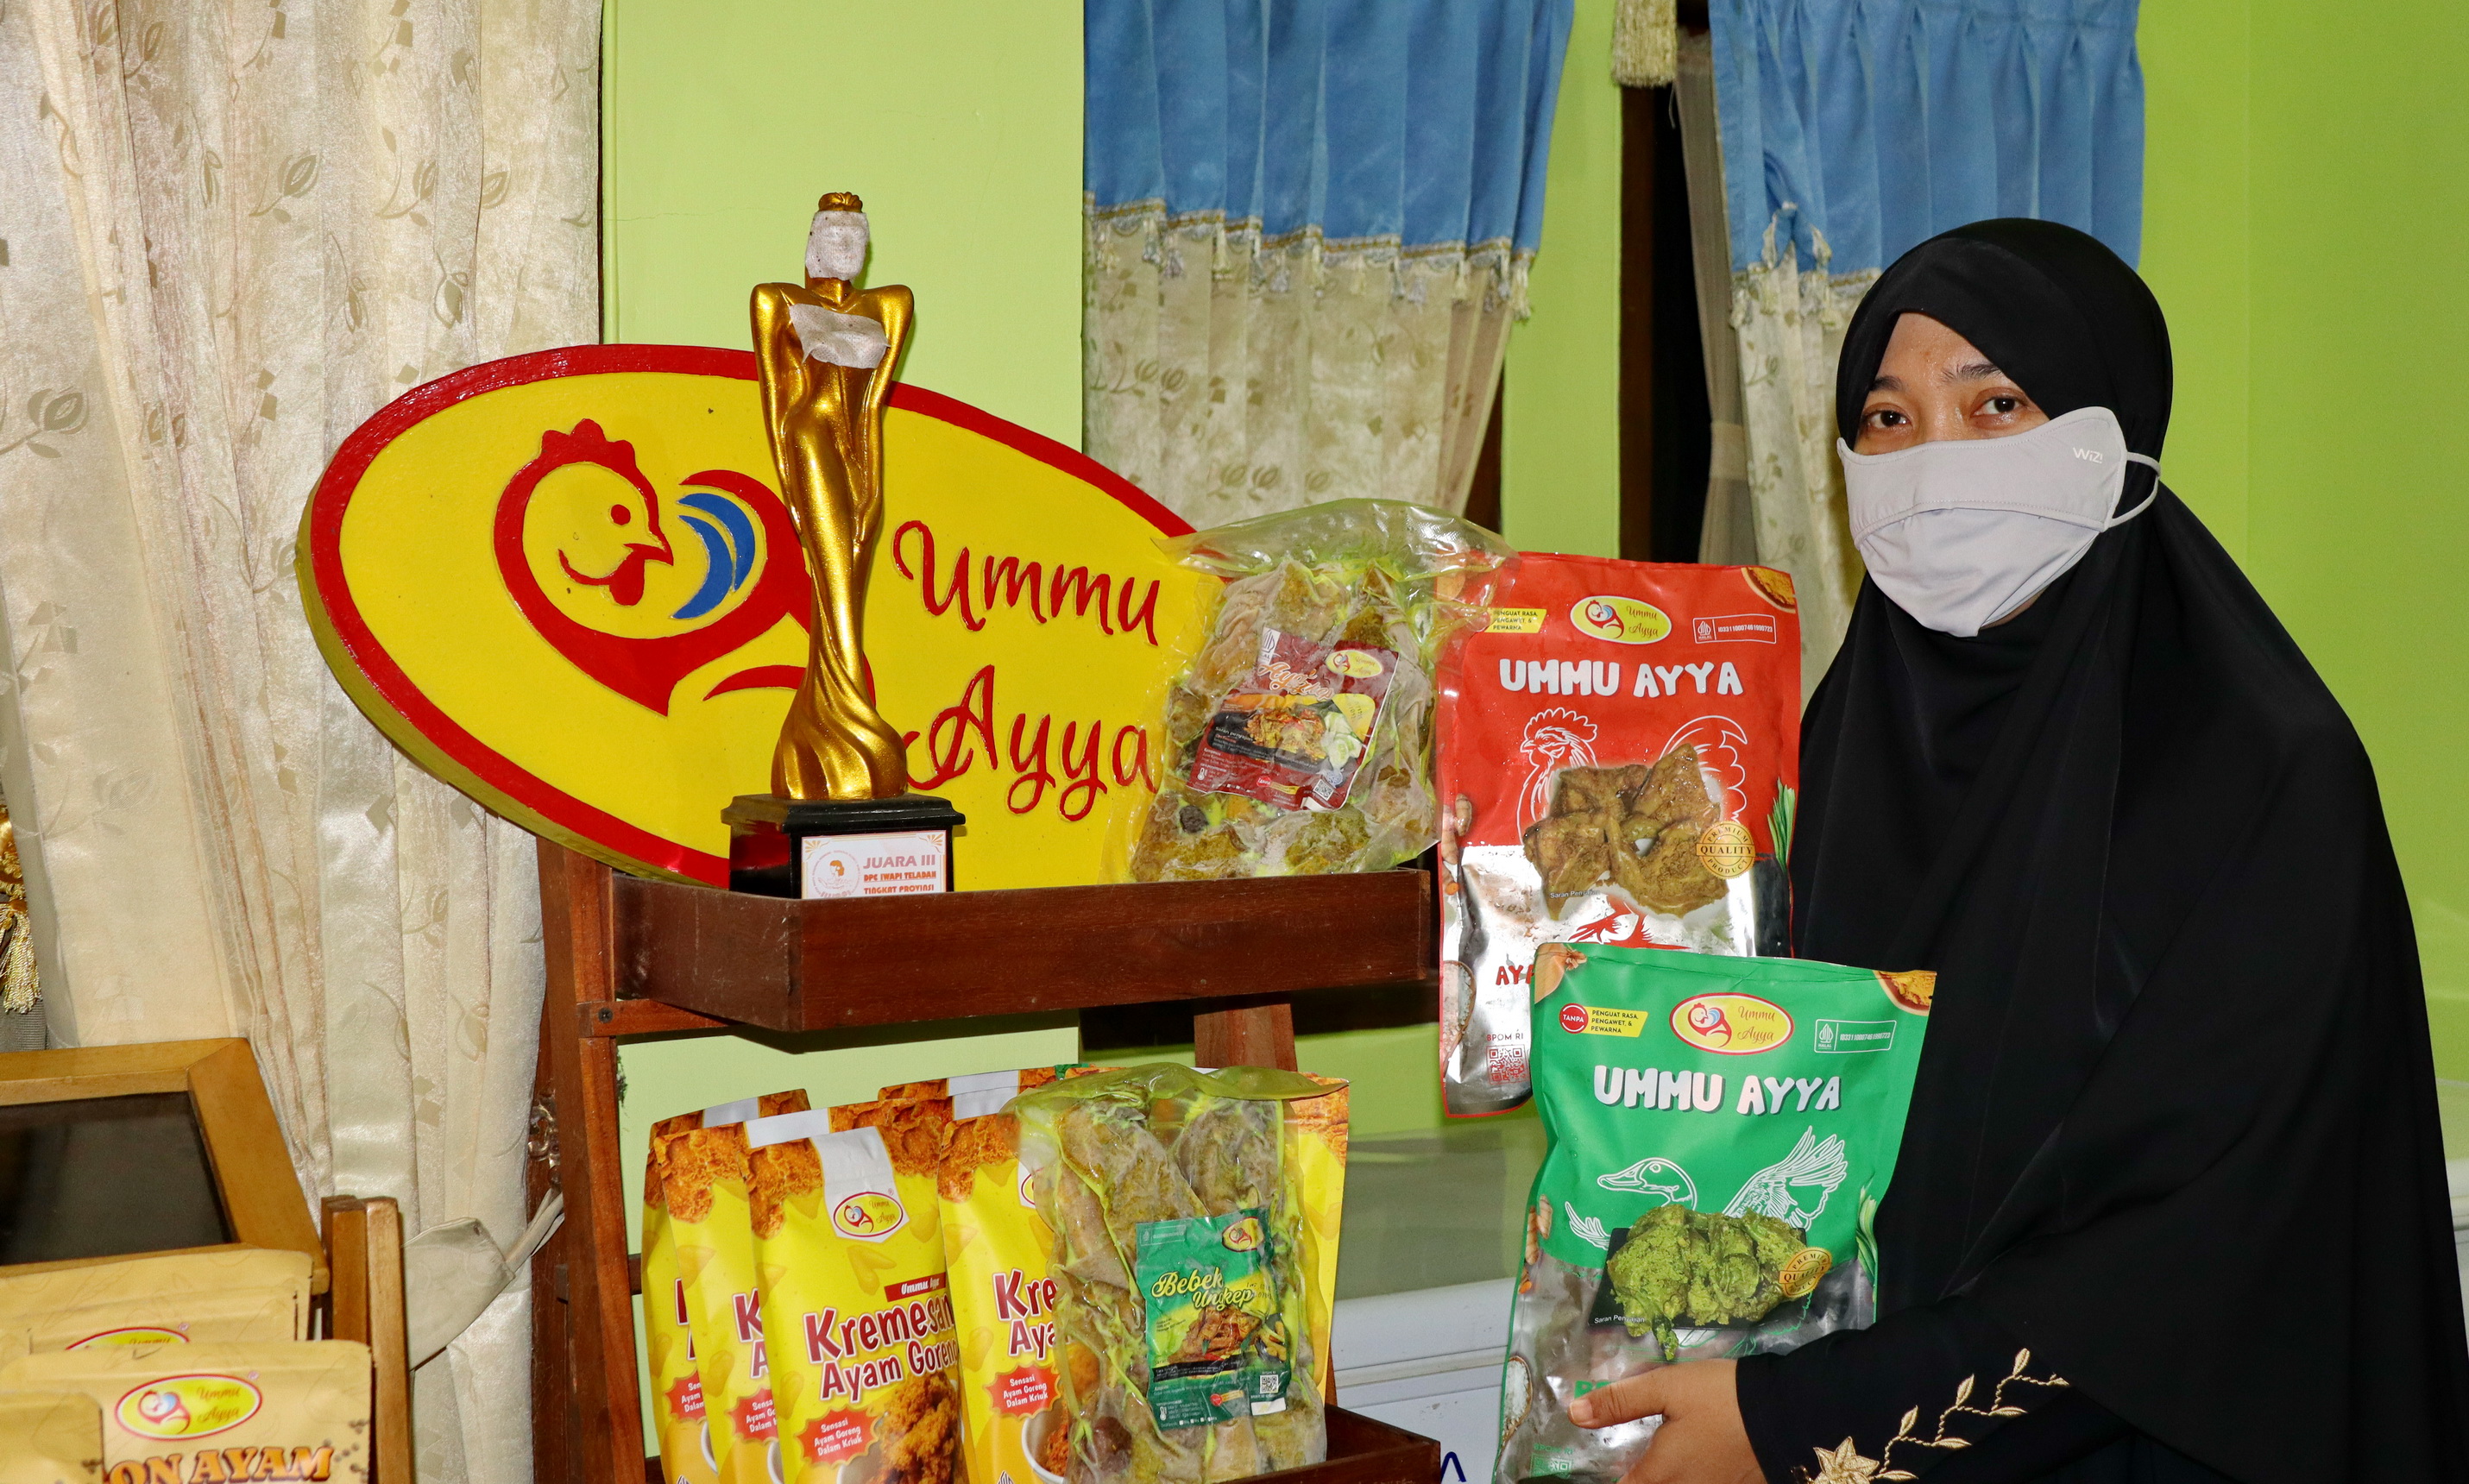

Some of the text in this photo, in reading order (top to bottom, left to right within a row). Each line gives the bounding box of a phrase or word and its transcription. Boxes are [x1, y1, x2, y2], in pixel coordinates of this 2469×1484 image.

[893, 520, 1160, 646] Ummu
[1627, 606, 1657, 620] Ummu
[1628, 622, 1659, 638] Ayya
[1499, 658, 1743, 698] UMMU AYYA
[903, 664, 1158, 821] Ayya
[1708, 827, 1748, 842] PREMIUM
[1700, 846, 1752, 855] QUALITY
[863, 854, 935, 869] JUARA III
[1708, 858, 1748, 873] PRODUCT
[864, 871, 936, 882] DPC IWAPI TELADAN
[898, 883, 934, 892] PROVINSI
[1563, 1014, 1584, 1023] TANPA
[1738, 1006, 1775, 1022] Ummu
[1737, 1026, 1774, 1044] Ayya
[1594, 1065, 1840, 1116] UMMU AYYA
[901, 1280, 929, 1294] Ummu
[1151, 1267, 1223, 1298] Bebek
[1193, 1286, 1255, 1311] Ungkep
[803, 1294, 954, 1363] Kremesan
[1009, 1318, 1056, 1361] Aya
[821, 1355, 903, 1403] Ayam
[1010, 1374, 1036, 1387] Sensasi
[197, 1386, 240, 1400] Ummu
[681, 1393, 701, 1404] Ayam
[1004, 1382, 1047, 1399] Ayam Goreng
[1006, 1391, 1049, 1408] Dalam Kriuk
[197, 1405, 239, 1422] Ayya
[746, 1413, 765, 1424] Ayam
[749, 1422, 772, 1433] Dalam
[821, 1417, 848, 1432] Sensasi
[815, 1426, 861, 1447] Ayam Goreng
[817, 1436, 862, 1456] Dalam Kriuk
[189, 1446, 335, 1484] AYAM
